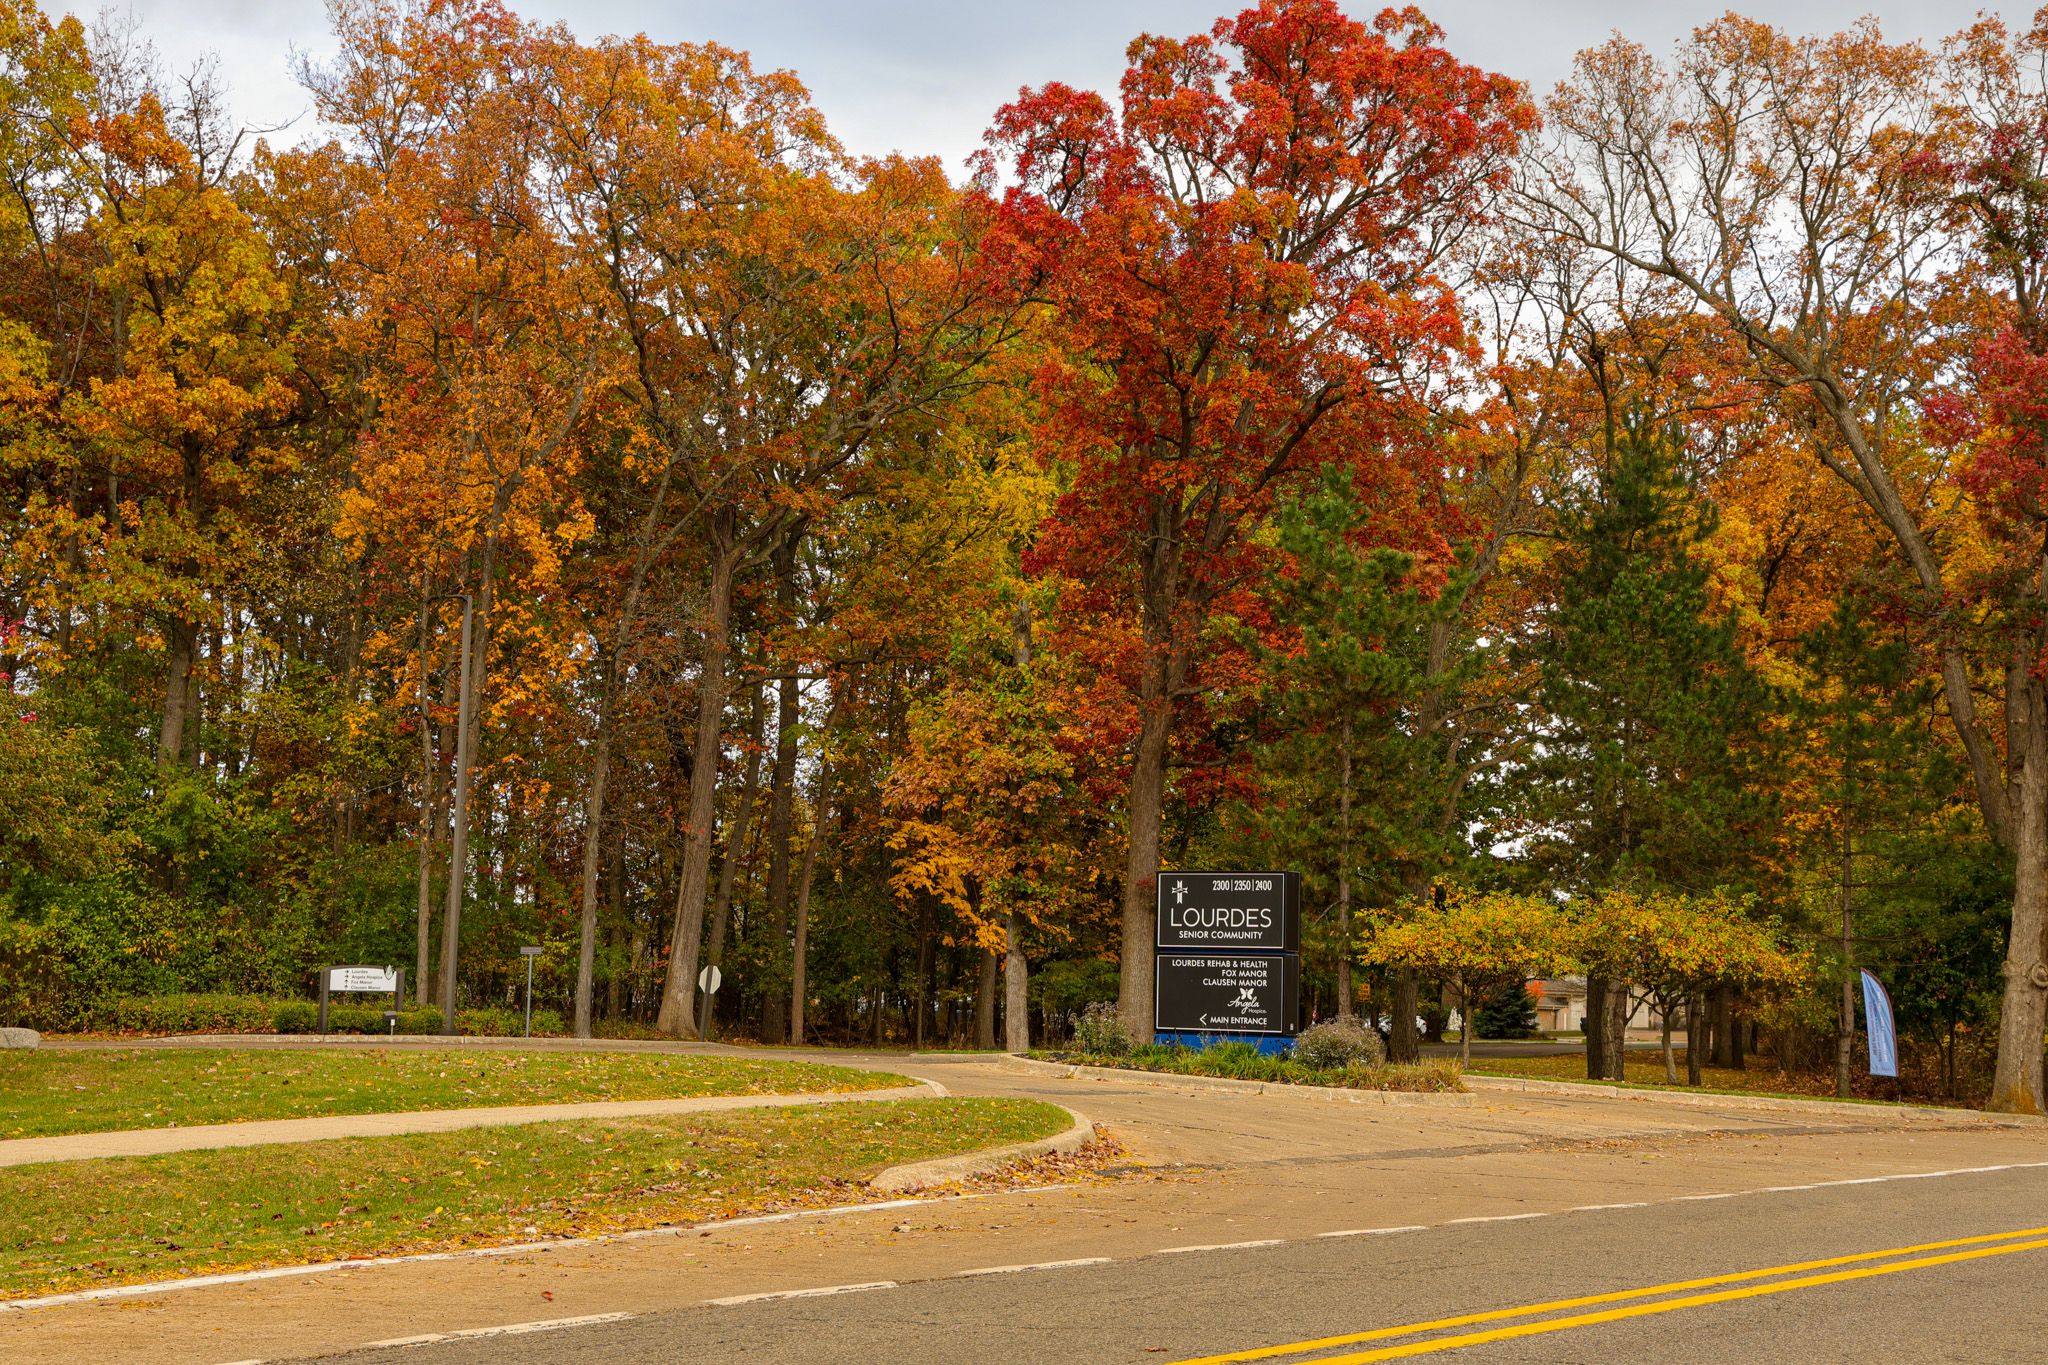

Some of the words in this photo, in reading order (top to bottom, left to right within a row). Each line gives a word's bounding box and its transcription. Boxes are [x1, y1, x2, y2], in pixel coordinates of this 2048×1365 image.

[1212, 879, 1230, 891] 2300
[1234, 879, 1251, 891] 2350
[1255, 879, 1272, 891] 2400
[1170, 907, 1272, 928] LOURDES
[1178, 930, 1209, 939] SENIOR
[1210, 931, 1263, 939] COMMUNITY
[1172, 959, 1205, 967] LOURDES
[1207, 960, 1231, 968] REHAB
[1232, 960, 1239, 968] &
[1240, 960, 1268, 968] HEALTH
[1221, 969, 1237, 977] FOX
[1238, 970, 1268, 978] MANOR
[1202, 978, 1237, 986] CLAUSEN
[1238, 979, 1268, 987] MANOR
[1227, 996, 1260, 1014] Angela
[1210, 1016, 1229, 1024] MAIN
[1230, 1017, 1268, 1025] ENTRANCE
